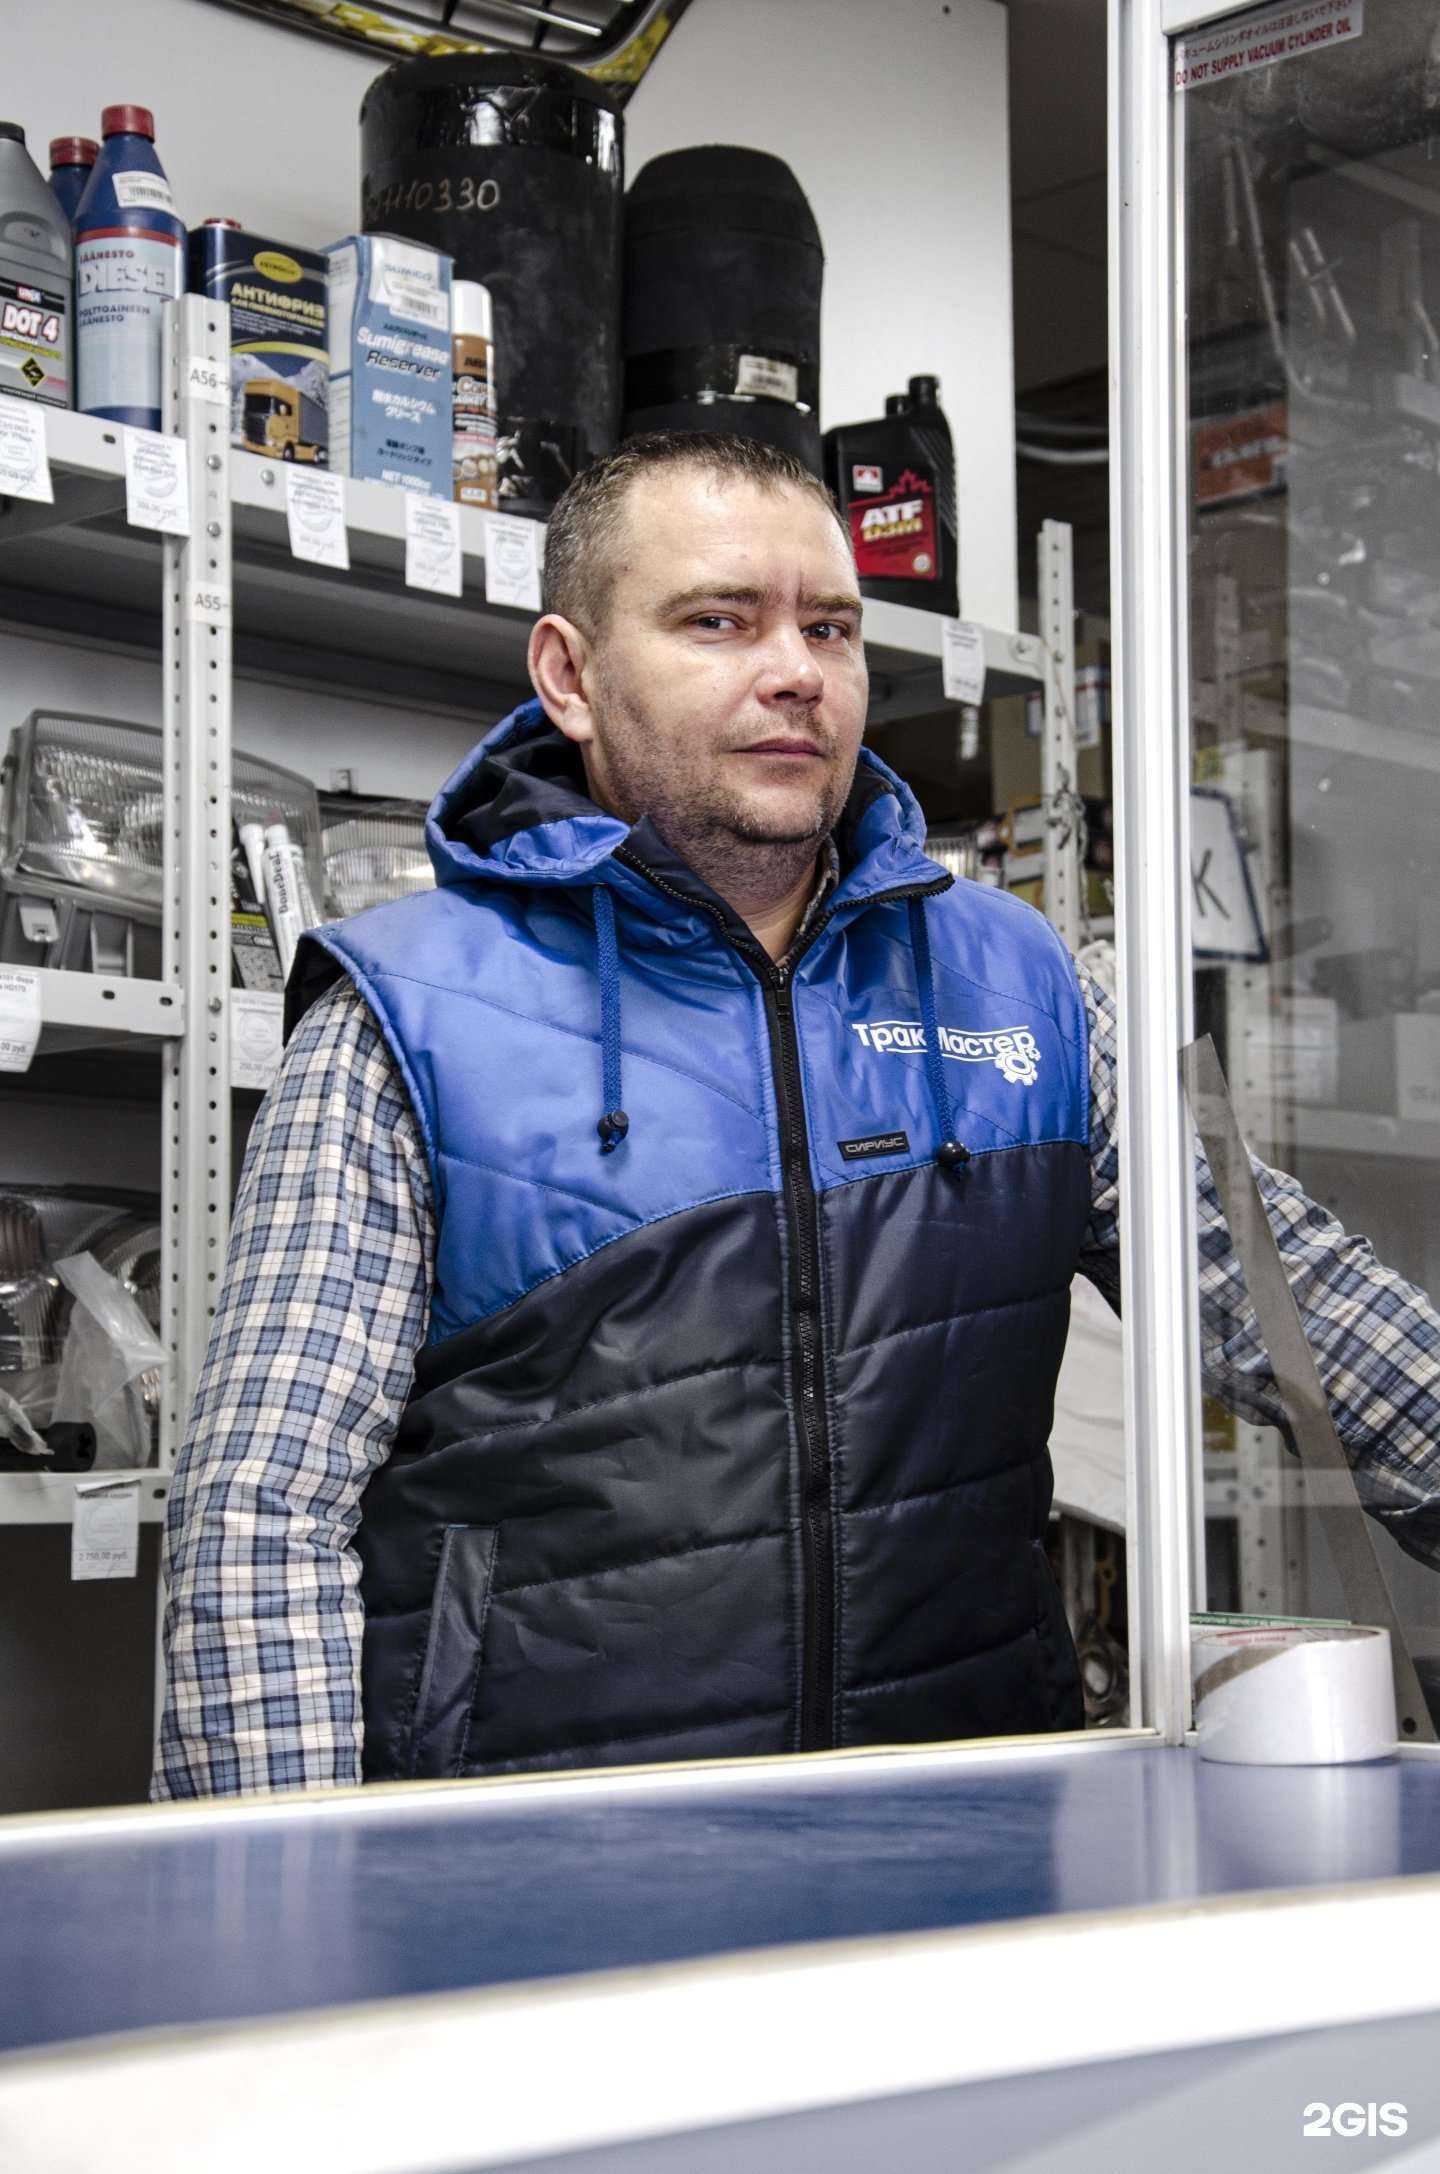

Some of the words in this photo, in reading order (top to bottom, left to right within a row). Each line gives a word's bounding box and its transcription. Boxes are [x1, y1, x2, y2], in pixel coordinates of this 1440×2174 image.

[1175, 69, 1188, 85] DO
[1190, 61, 1210, 81] NOT
[1211, 51, 1245, 76] SUPPLY
[1247, 39, 1286, 62] VACUUM
[1288, 22, 1333, 49] CYLINDER
[1336, 18, 1352, 35] OIL
[230, 282, 325, 320] АНТИФРИЗ
[3, 303, 41, 337] DOT
[42, 316, 59, 342] 4
[191, 368, 217, 388] A56
[366, 350, 440, 378] Reserver
[861, 499, 923, 528] ATF
[195, 593, 221, 610] A55
[845, 1137, 905, 1153] СИРИУС
